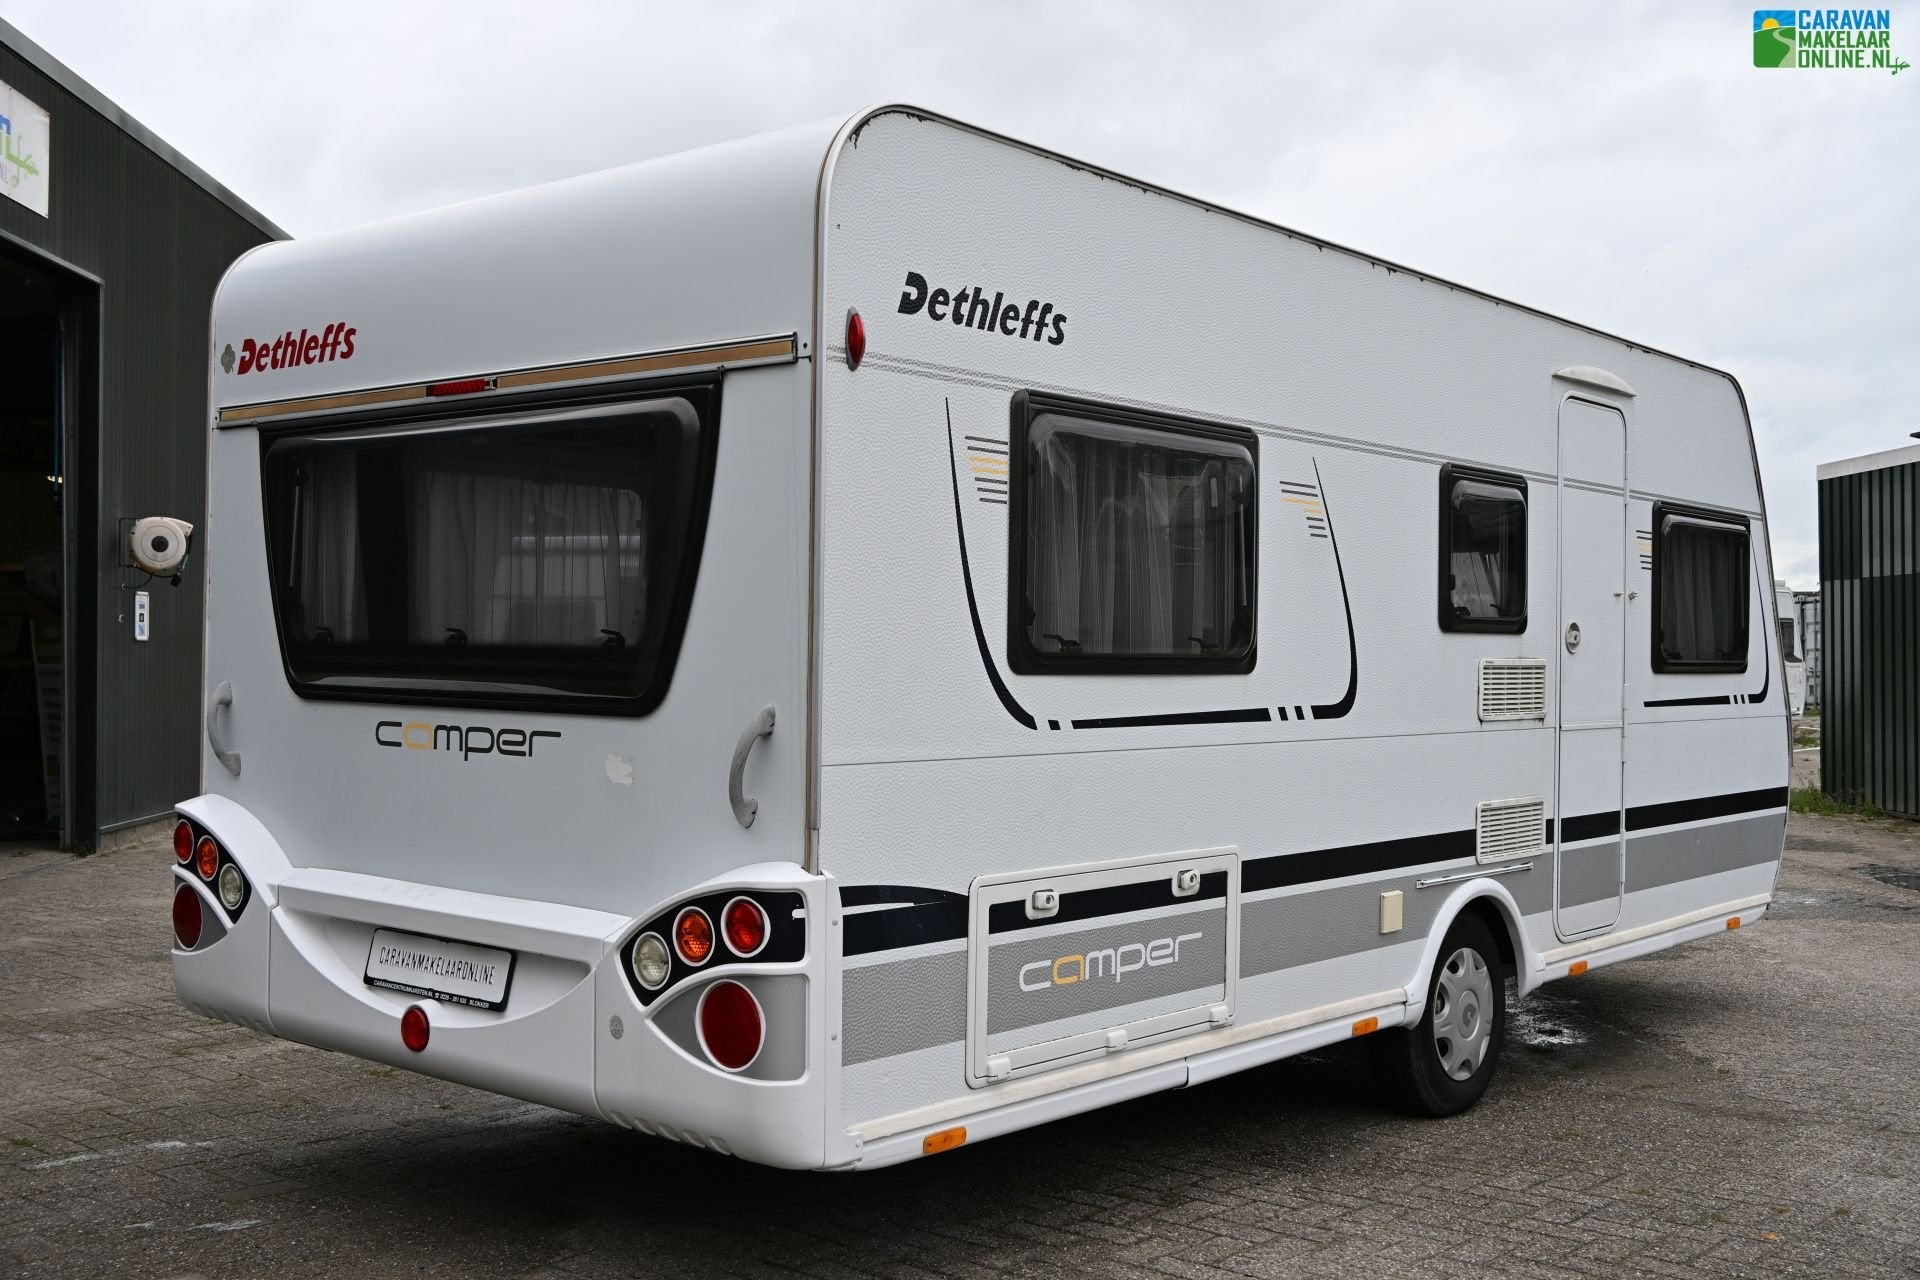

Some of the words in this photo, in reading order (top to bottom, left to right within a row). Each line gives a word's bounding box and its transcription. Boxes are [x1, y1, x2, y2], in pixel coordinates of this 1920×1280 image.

[897, 271, 1067, 346] Dethleffs
[237, 321, 357, 376] Dethleffs
[375, 720, 562, 762] camper
[379, 946, 496, 985] CARAVANMAKELAARONLINE
[1018, 931, 1203, 993] camper
